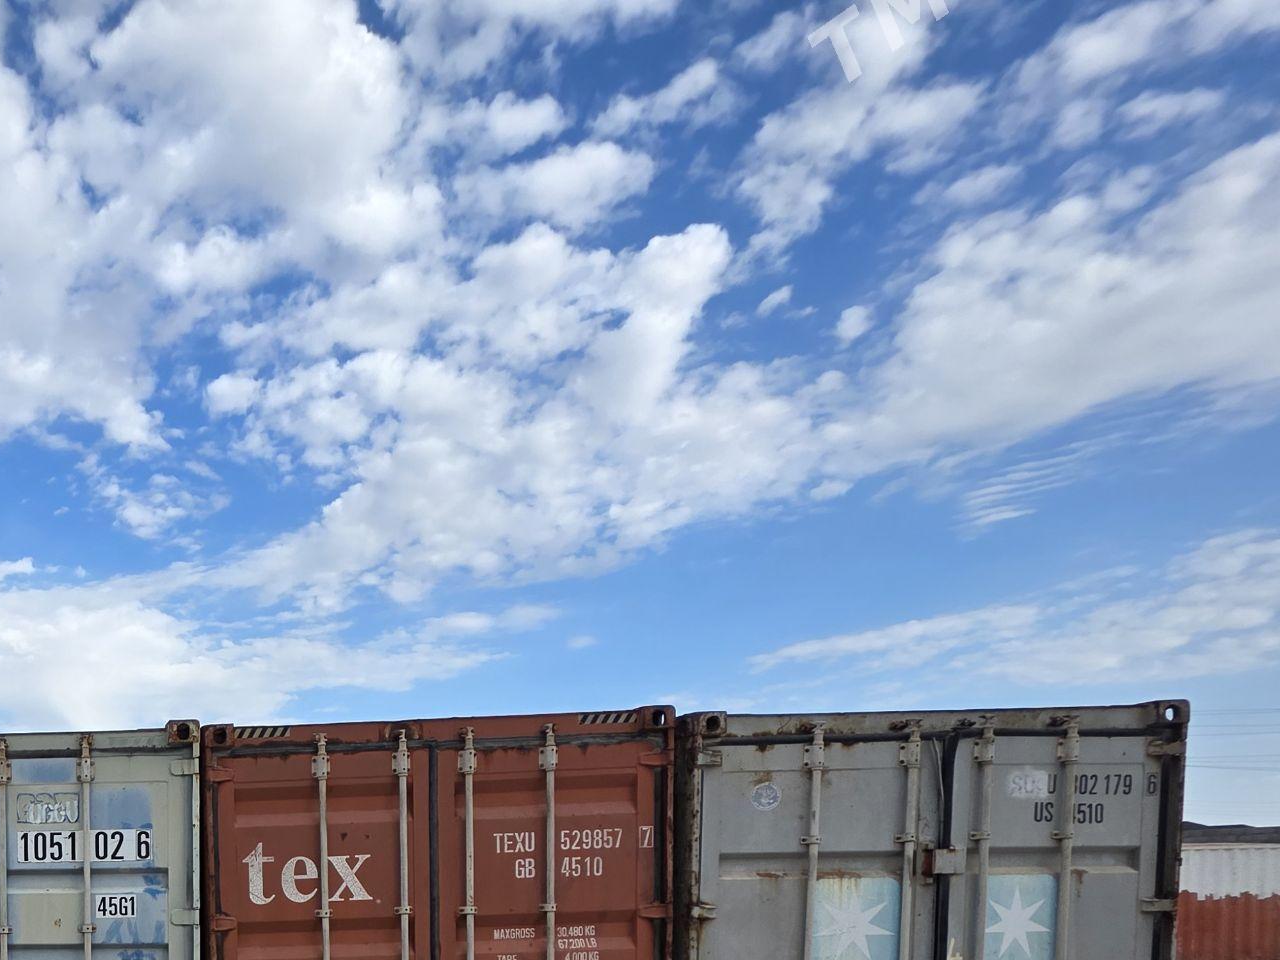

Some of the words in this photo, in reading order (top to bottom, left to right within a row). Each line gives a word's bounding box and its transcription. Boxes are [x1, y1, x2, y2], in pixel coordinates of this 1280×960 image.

[1147, 775, 1158, 794] 6
[1034, 802, 1054, 822] US
[1072, 803, 1103, 824] 510
[20, 832, 76, 861] 1051
[137, 831, 150, 859] 6
[493, 832, 535, 853] TEXU
[560, 829, 622, 850] 529857
[242, 842, 373, 905] tex
[515, 858, 535, 879] GB
[561, 857, 603, 877] 4510
[98, 896, 135, 916] 45G1
[585, 925, 595, 936] KG
[585, 938, 597, 948] LB
[588, 951, 599, 960] KG
